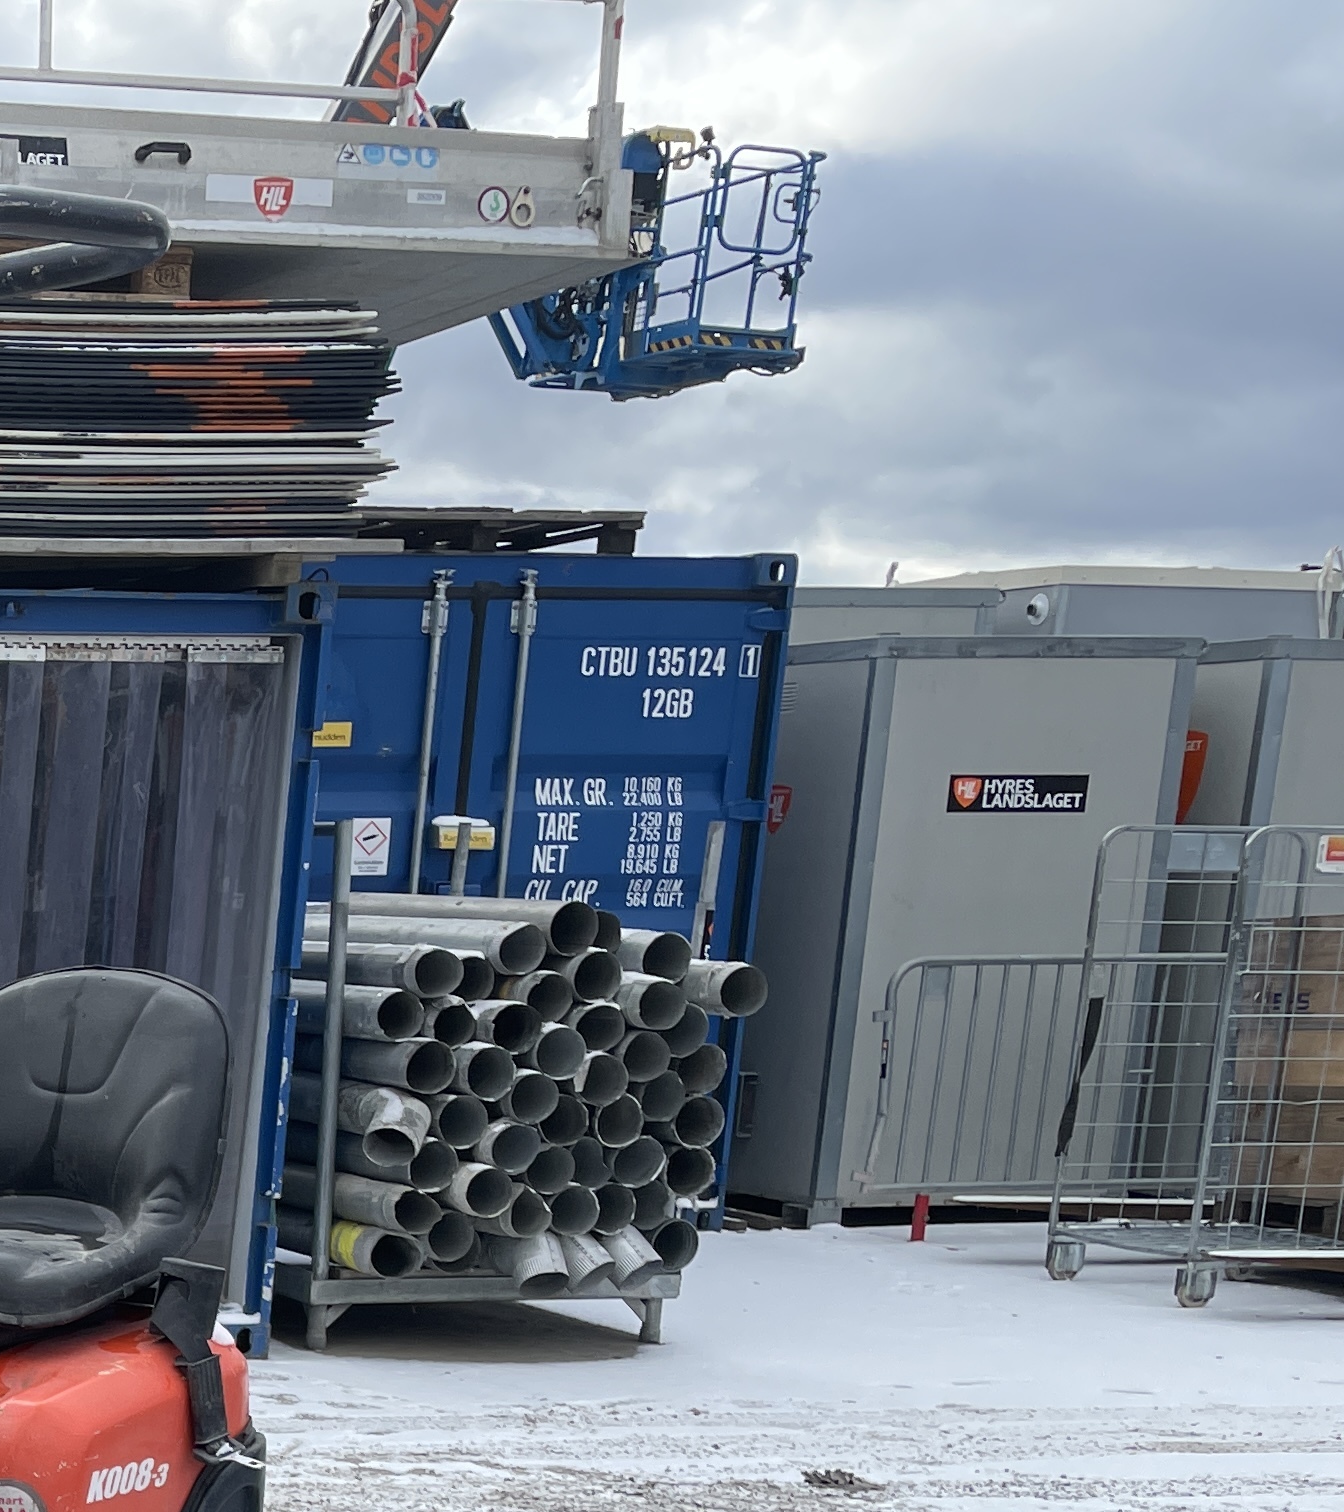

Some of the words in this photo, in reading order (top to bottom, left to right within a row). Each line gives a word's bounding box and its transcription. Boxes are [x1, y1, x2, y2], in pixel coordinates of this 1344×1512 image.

[580, 646, 638, 677] CTBU
[647, 646, 726, 677] 135124
[642, 688, 694, 718] 12GB
[534, 777, 580, 806] MAX.
[583, 777, 614, 806] GR.
[667, 776, 683, 792] KG
[983, 778, 1035, 794] HYRES
[667, 792, 683, 807] LB
[982, 793, 1084, 809] LANDSLAGET
[537, 812, 581, 842] TARE
[667, 812, 683, 827] KG
[666, 827, 682, 842] LB
[531, 844, 569, 874] NET
[664, 844, 681, 859] KG
[662, 859, 678, 874] LB
[625, 892, 647, 908] 564
[85, 1457, 170, 1505] K008-3
